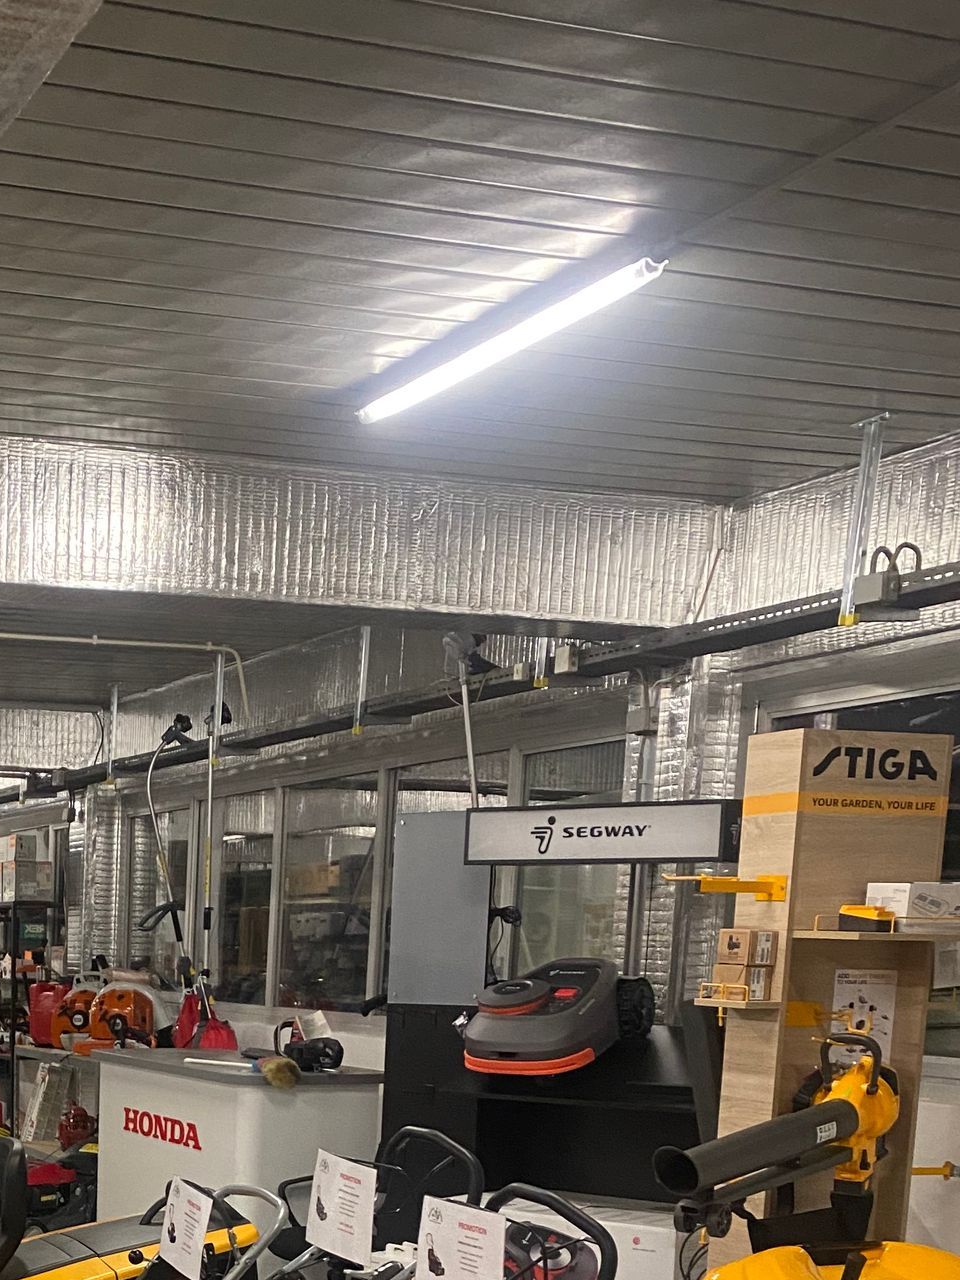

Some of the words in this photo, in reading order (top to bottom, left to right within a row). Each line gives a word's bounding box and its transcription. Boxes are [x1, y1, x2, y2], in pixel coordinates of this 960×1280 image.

[813, 746, 938, 781] STIGA
[812, 797, 839, 807] YOUR
[841, 799, 885, 811] GARDEN,
[887, 800, 913, 810] YOUR
[915, 801, 936, 811] LIFE
[562, 825, 648, 838] SEGWAY
[123, 1106, 202, 1151] HONDA
